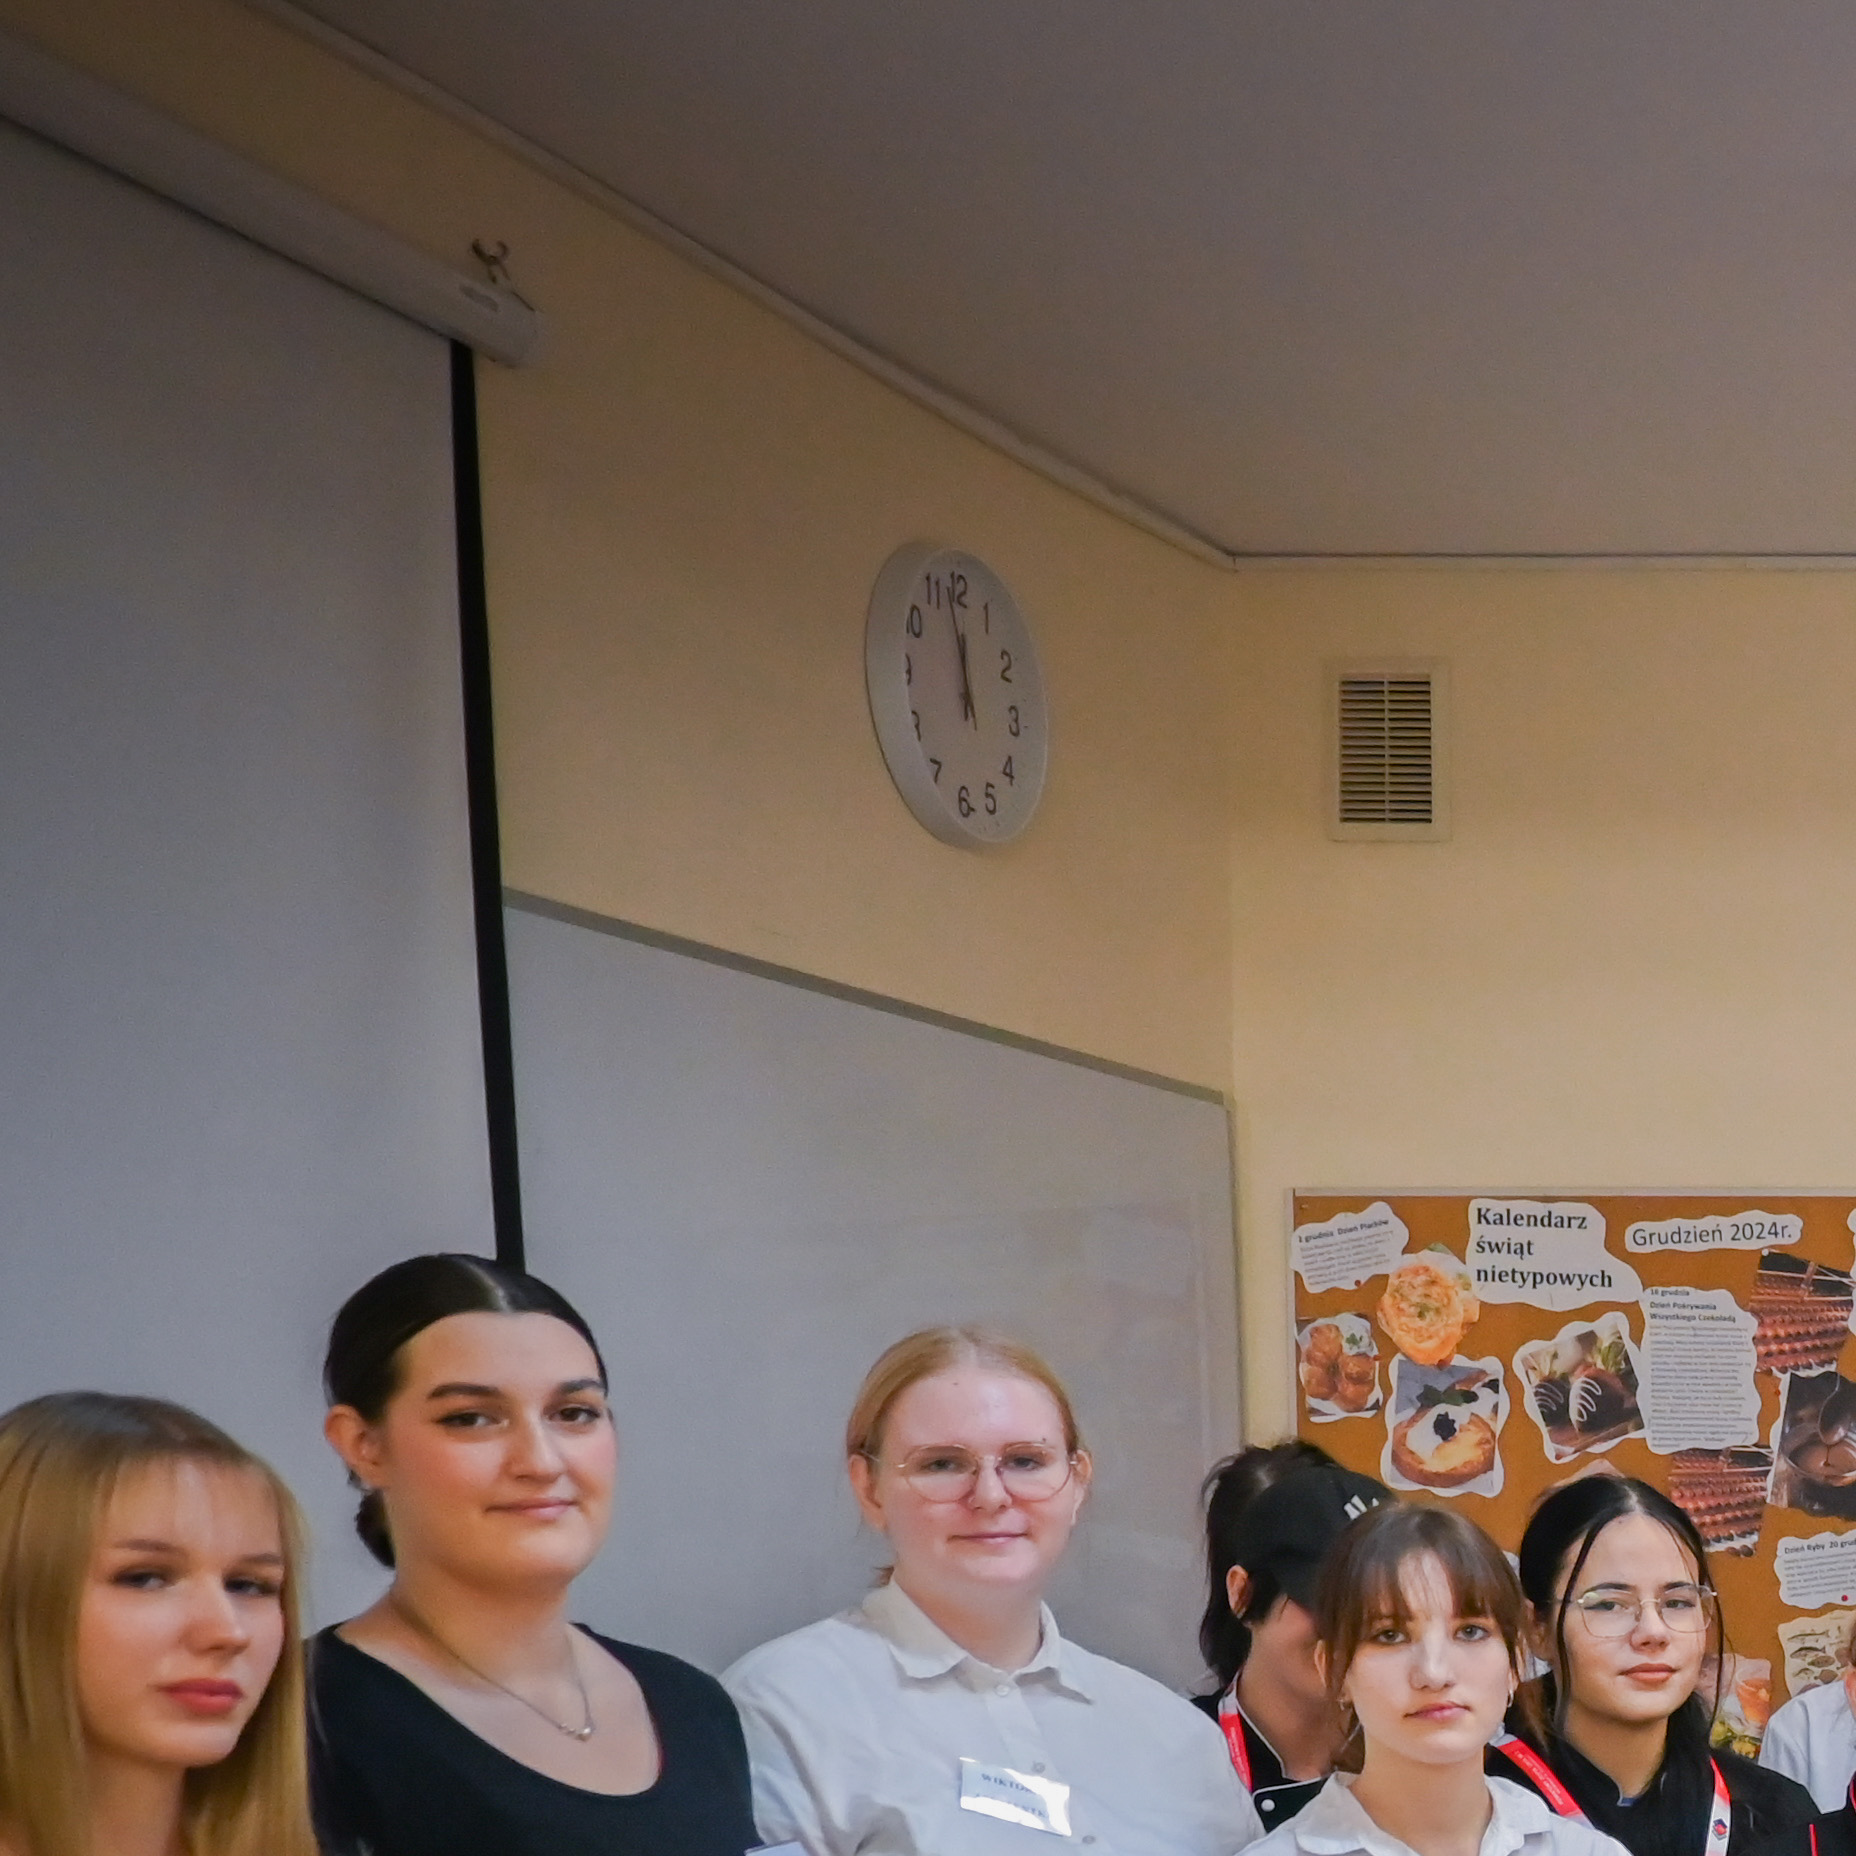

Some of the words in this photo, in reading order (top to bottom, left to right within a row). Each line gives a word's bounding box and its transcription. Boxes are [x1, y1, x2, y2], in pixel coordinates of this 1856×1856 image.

[982, 602, 989, 635] 1
[1000, 649, 1013, 683] 2
[1008, 705, 1020, 737] 3
[929, 757, 942, 784] 7
[1002, 755, 1015, 786] 4
[957, 785, 975, 818] 6
[984, 782, 997, 815] 5
[1475, 1207, 1588, 1231] Kalendarz
[1632, 1223, 1724, 1247] Grudzień
[1730, 1219, 1793, 1242] 2024r.
[1475, 1236, 1534, 1259] świąt
[1475, 1266, 1613, 1291] nietypowych
